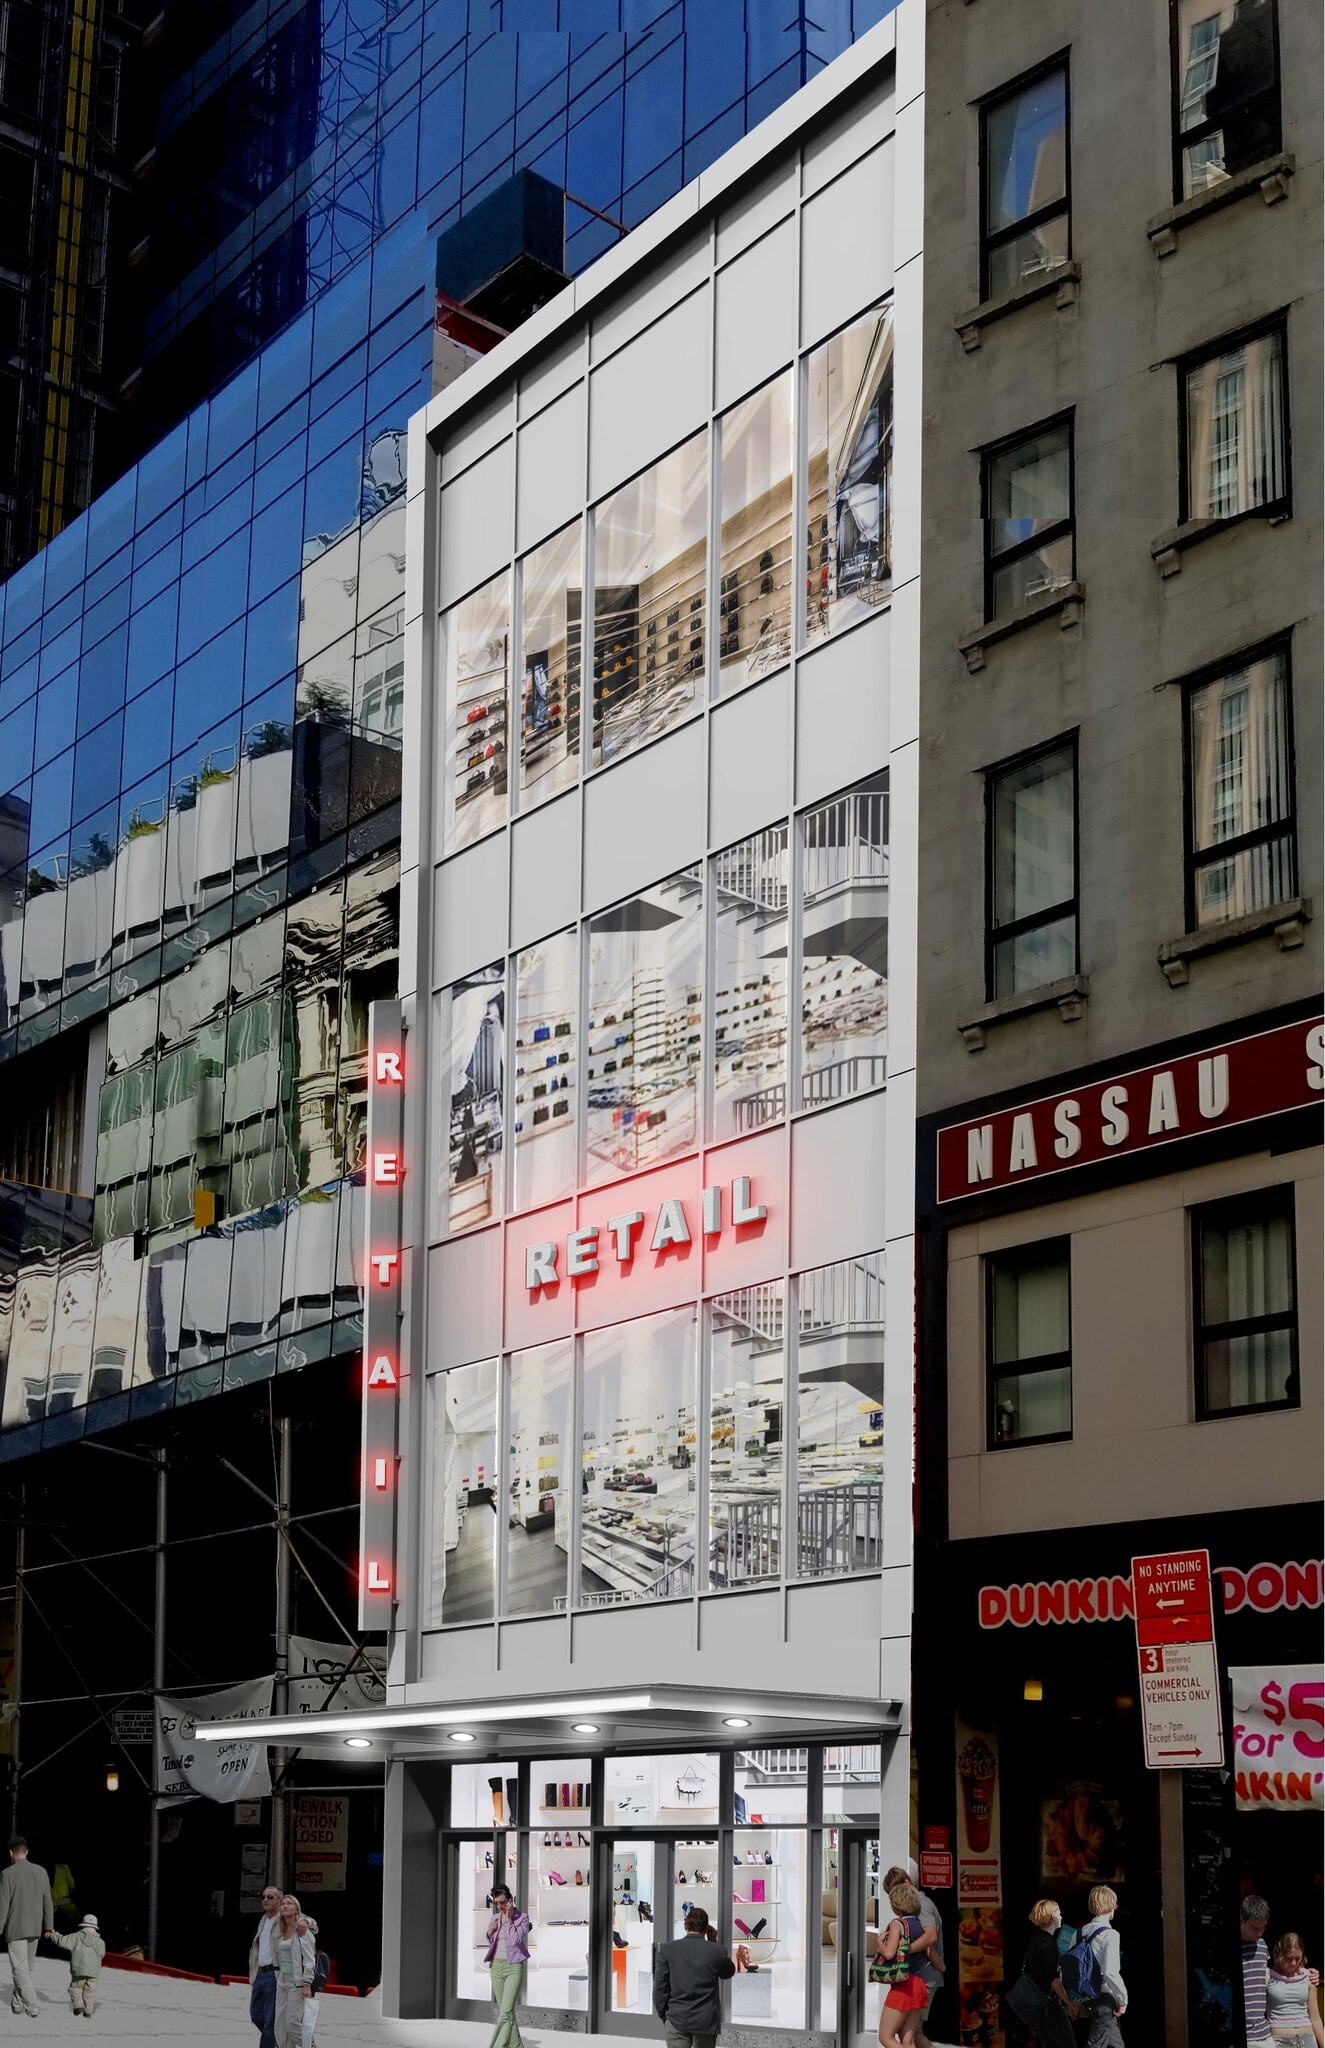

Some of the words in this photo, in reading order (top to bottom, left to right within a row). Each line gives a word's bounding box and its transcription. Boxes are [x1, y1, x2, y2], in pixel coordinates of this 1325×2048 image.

[967, 1053, 1230, 1184] NASSAU
[524, 1176, 768, 1291] RETAIL
[367, 1052, 403, 1590] RETAIL
[1139, 1565, 1152, 1578] NO
[1156, 1560, 1202, 1576] STANDING
[1148, 1579, 1196, 1595] ANYTIME
[1212, 1559, 1324, 1615] DON
[1145, 1648, 1159, 1672] 3
[1145, 1677, 1202, 1690] COMMERCIAL
[1146, 1691, 1187, 1703] VEHICLES
[1188, 1690, 1211, 1701] ONLY
[1148, 1723, 1163, 1732] 7am
[1169, 1722, 1184, 1731] 7pm
[1148, 1734, 1171, 1744] Except
[1172, 1733, 1197, 1743] Sunday
[1233, 1725, 1285, 1758] for
[221, 1757, 249, 1775] OPEN
[299, 1800, 343, 1814] EWALK
[296, 1815, 337, 1829] CTION
[295, 1830, 335, 1843] LOSED
